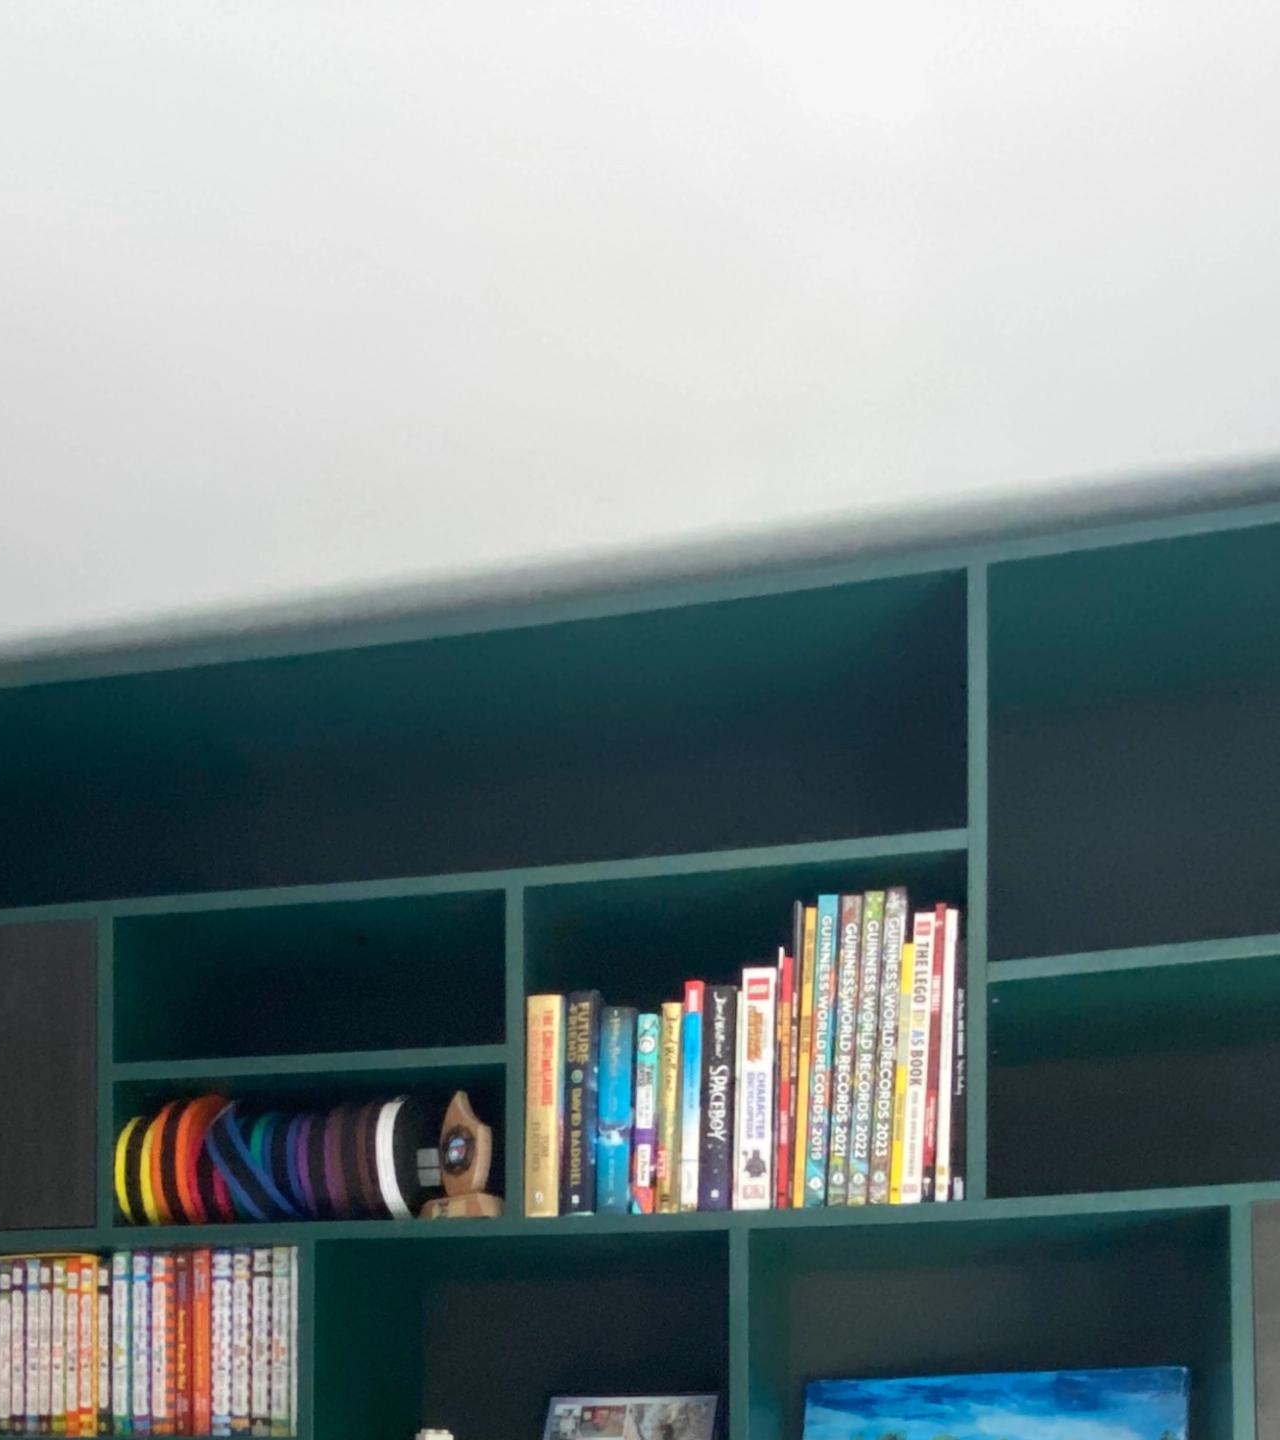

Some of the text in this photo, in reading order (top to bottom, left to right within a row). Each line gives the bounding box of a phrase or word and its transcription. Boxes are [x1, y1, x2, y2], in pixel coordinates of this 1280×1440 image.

[912, 970, 928, 1003] LEGO
[914, 941, 929, 967] THE
[576, 1001, 589, 1063] FUTURE
[811, 915, 833, 1160] GUINNESS WORLD RECORDS 2019
[834, 923, 858, 1157] GUINNESS WORLD RECORDS 2021
[854, 921, 879, 1158] GUINNESS WORLD RECORDS 2022
[875, 918, 899, 1157] GUINNESS WORLD RECORDS 2023
[907, 1049, 923, 1087] BOOK
[569, 1088, 581, 1187] DAVID BADDIEL
[705, 1064, 729, 1141] SPACEBOY
[753, 1072, 766, 1138] CHARACTER
